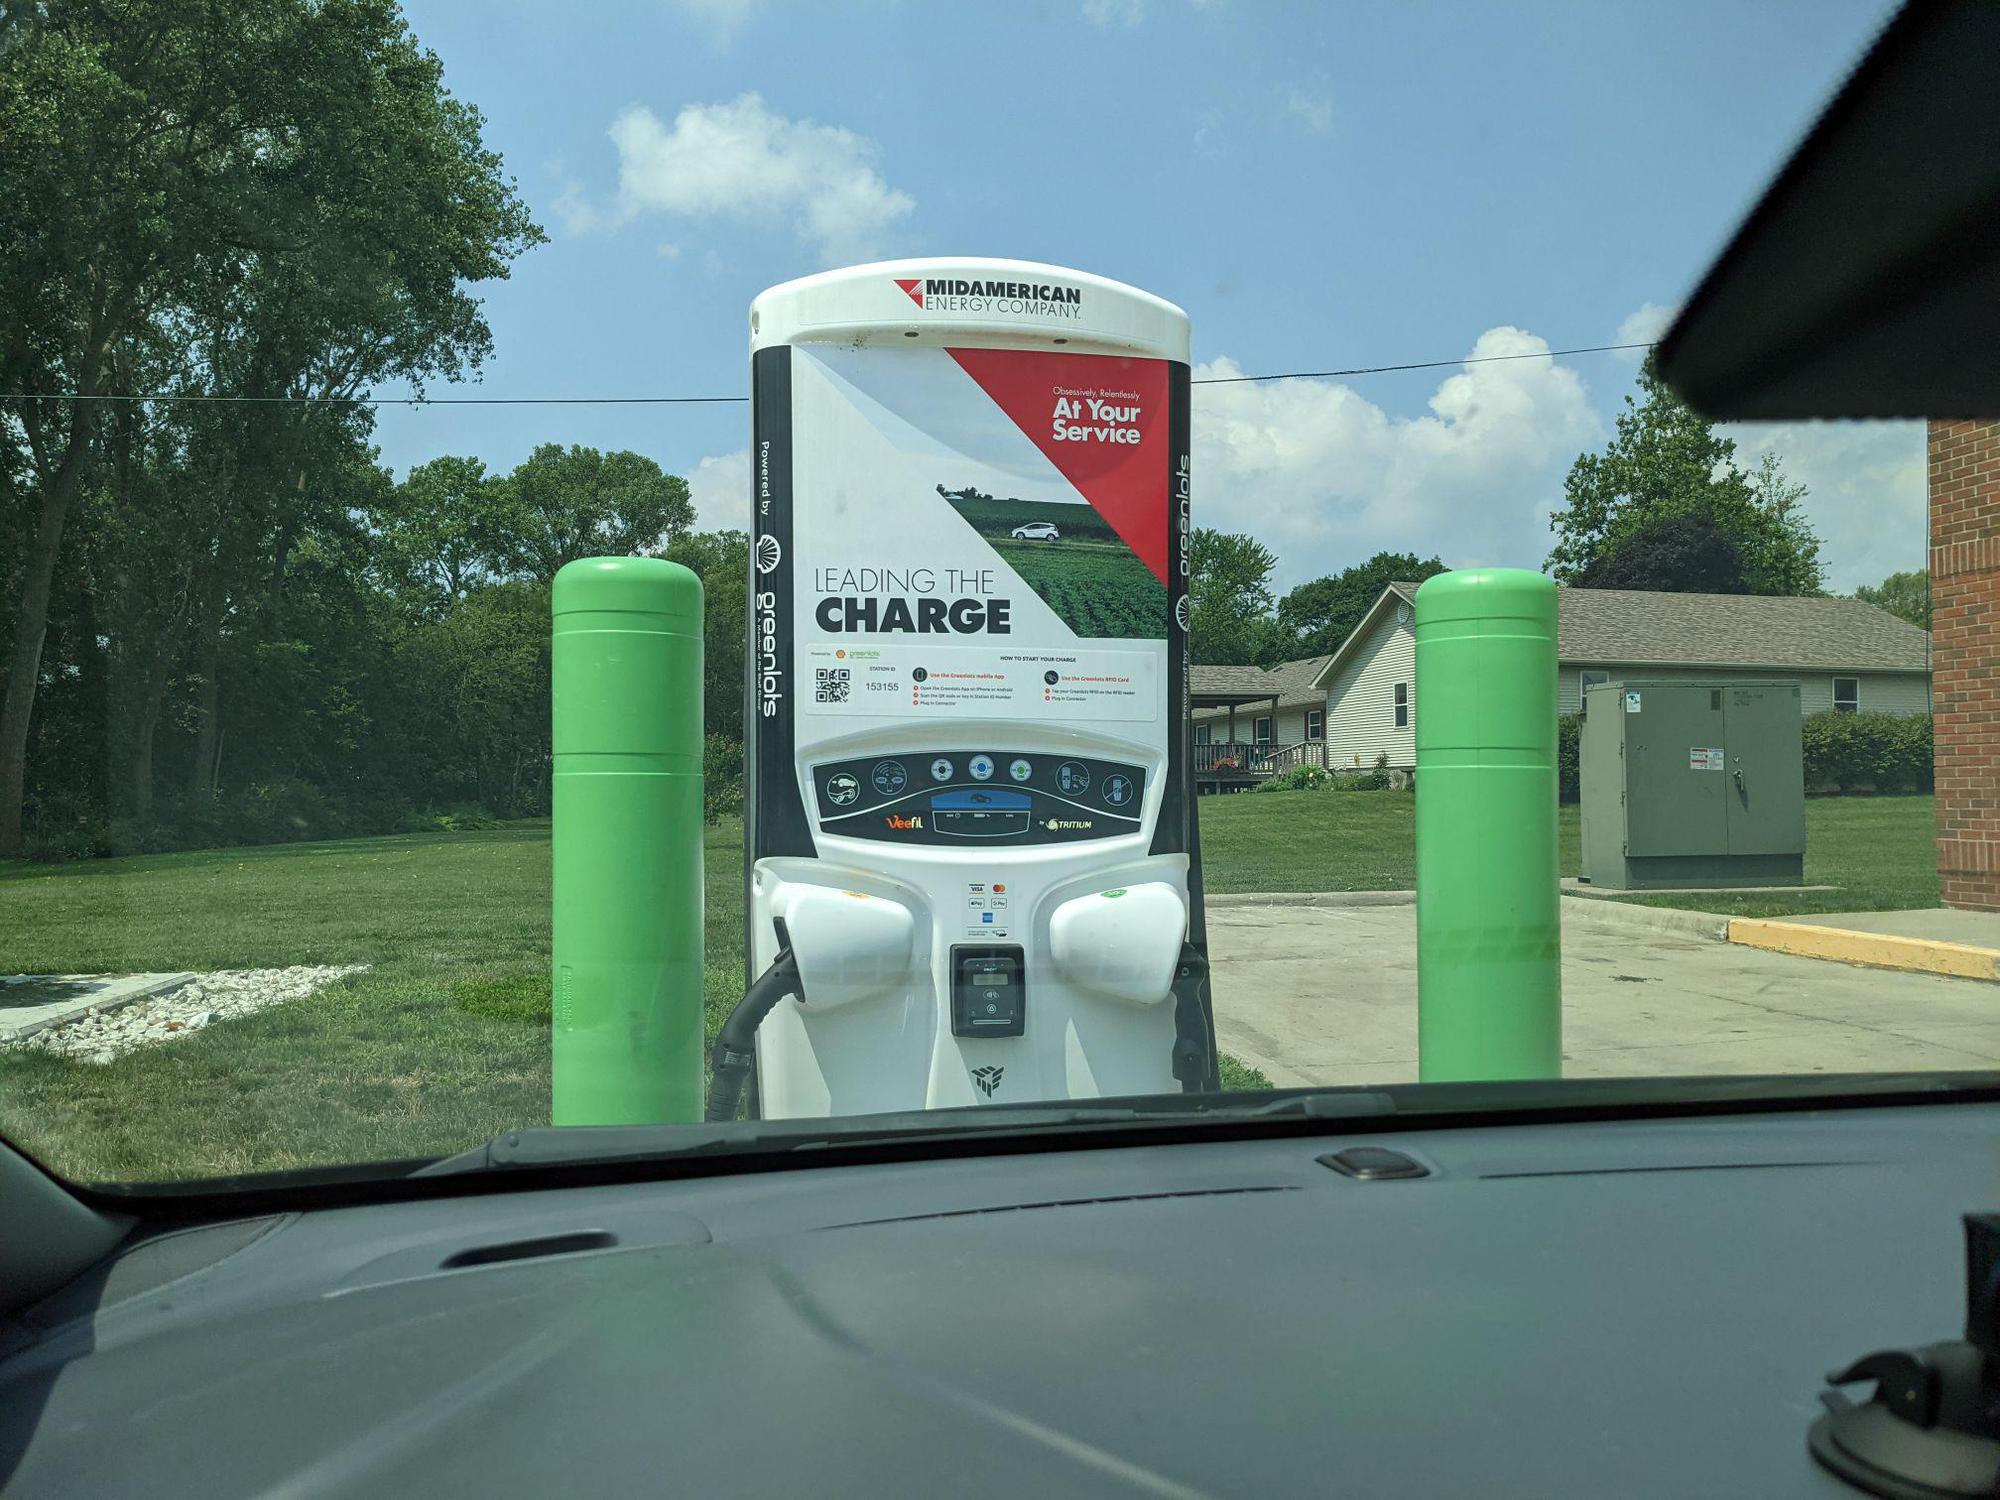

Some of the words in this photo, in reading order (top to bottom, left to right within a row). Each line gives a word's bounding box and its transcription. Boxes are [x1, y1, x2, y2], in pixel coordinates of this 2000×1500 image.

[926, 280, 1080, 304] MIDAMERICAN
[926, 296, 993, 312] ENERGY
[1052, 386, 1098, 398] Obsessively,
[1100, 388, 1140, 402] Relentlessly
[1052, 397, 1082, 419] At
[1086, 399, 1141, 422] Your
[1052, 418, 1140, 445] Service
[761, 441, 770, 496] Powered
[760, 500, 770, 515] by
[816, 568, 936, 594] LEADING
[945, 569, 994, 594] THE
[815, 596, 1011, 634] CHARGE
[756, 592, 782, 717] greenlots
[866, 682, 899, 691] 153155
[885, 815, 924, 829] Veefil
